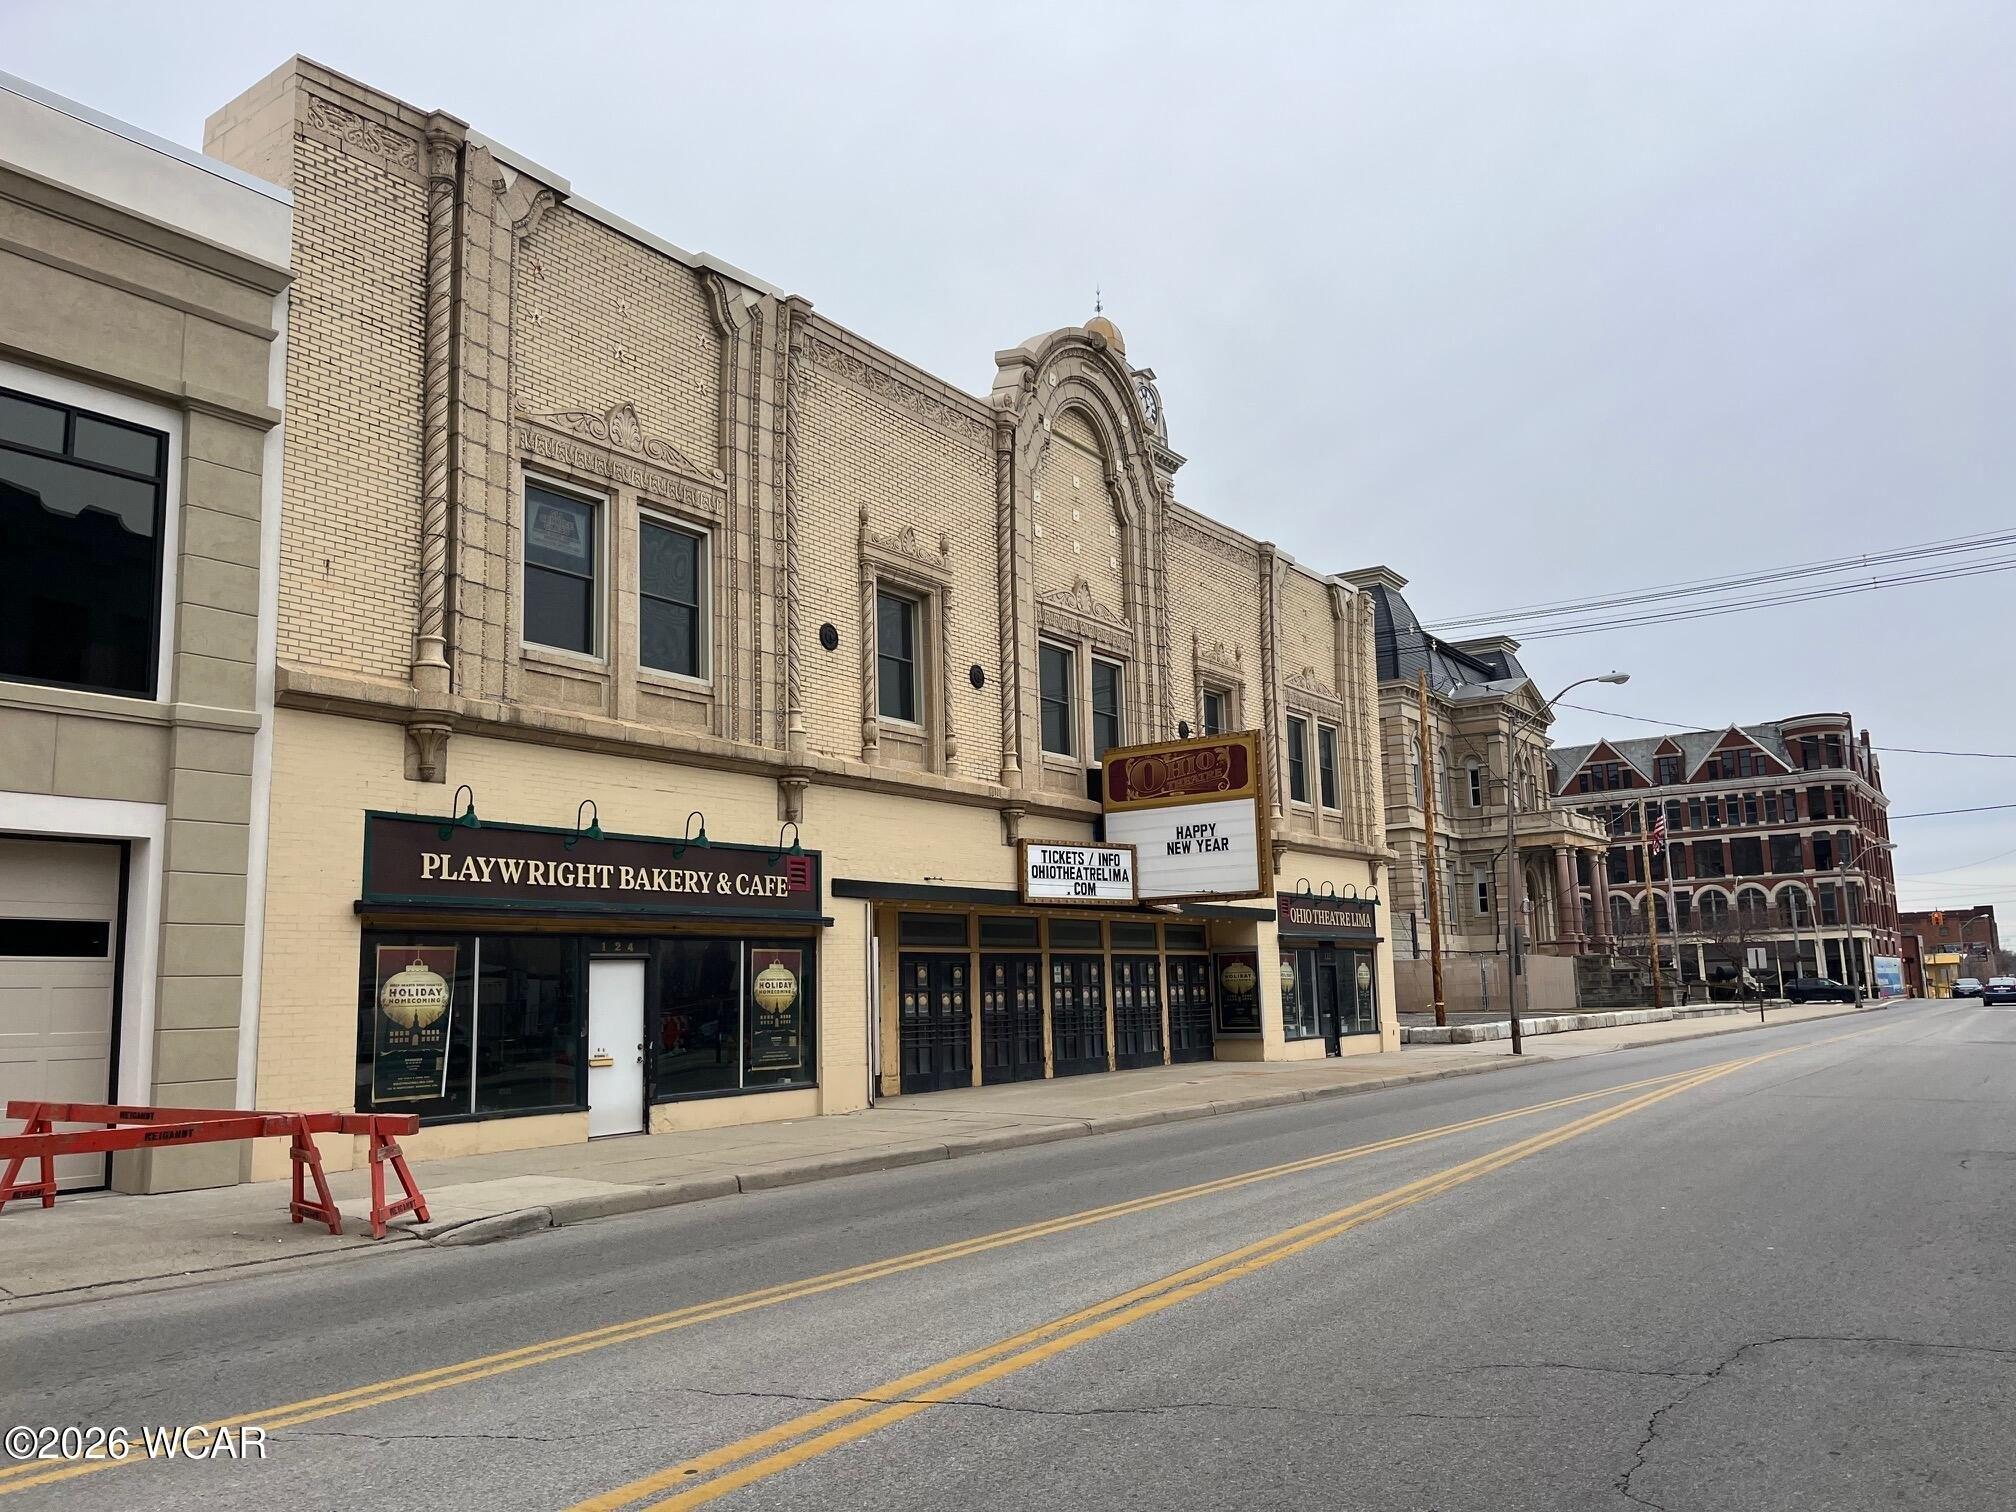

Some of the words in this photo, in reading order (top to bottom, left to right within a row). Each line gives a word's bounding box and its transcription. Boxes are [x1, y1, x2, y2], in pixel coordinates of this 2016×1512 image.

[1130, 751, 1216, 793] OHIO
[1167, 768, 1224, 790] THEATRE
[1176, 823, 1216, 839] HAPPY
[1167, 841, 1191, 855] NEW
[1196, 837, 1229, 853] YEAR
[1041, 850, 1084, 865] TICKETS
[1088, 852, 1094, 865] /
[1098, 853, 1120, 866] INFO
[420, 852, 614, 889] PLAYWRIGHT
[619, 866, 713, 894] BAKERY
[716, 872, 733, 895] &
[735, 873, 789, 898] CAFE
[1031, 865, 1129, 882] OHIOTHEATRELIMA
[1290, 907, 1312, 924] OHIO
[1313, 909, 1351, 927] THEATRE
[1351, 912, 1372, 928] LIMA
[389, 988, 443, 997] HOLIDAY
[759, 981, 793, 989] HOLIDAY
